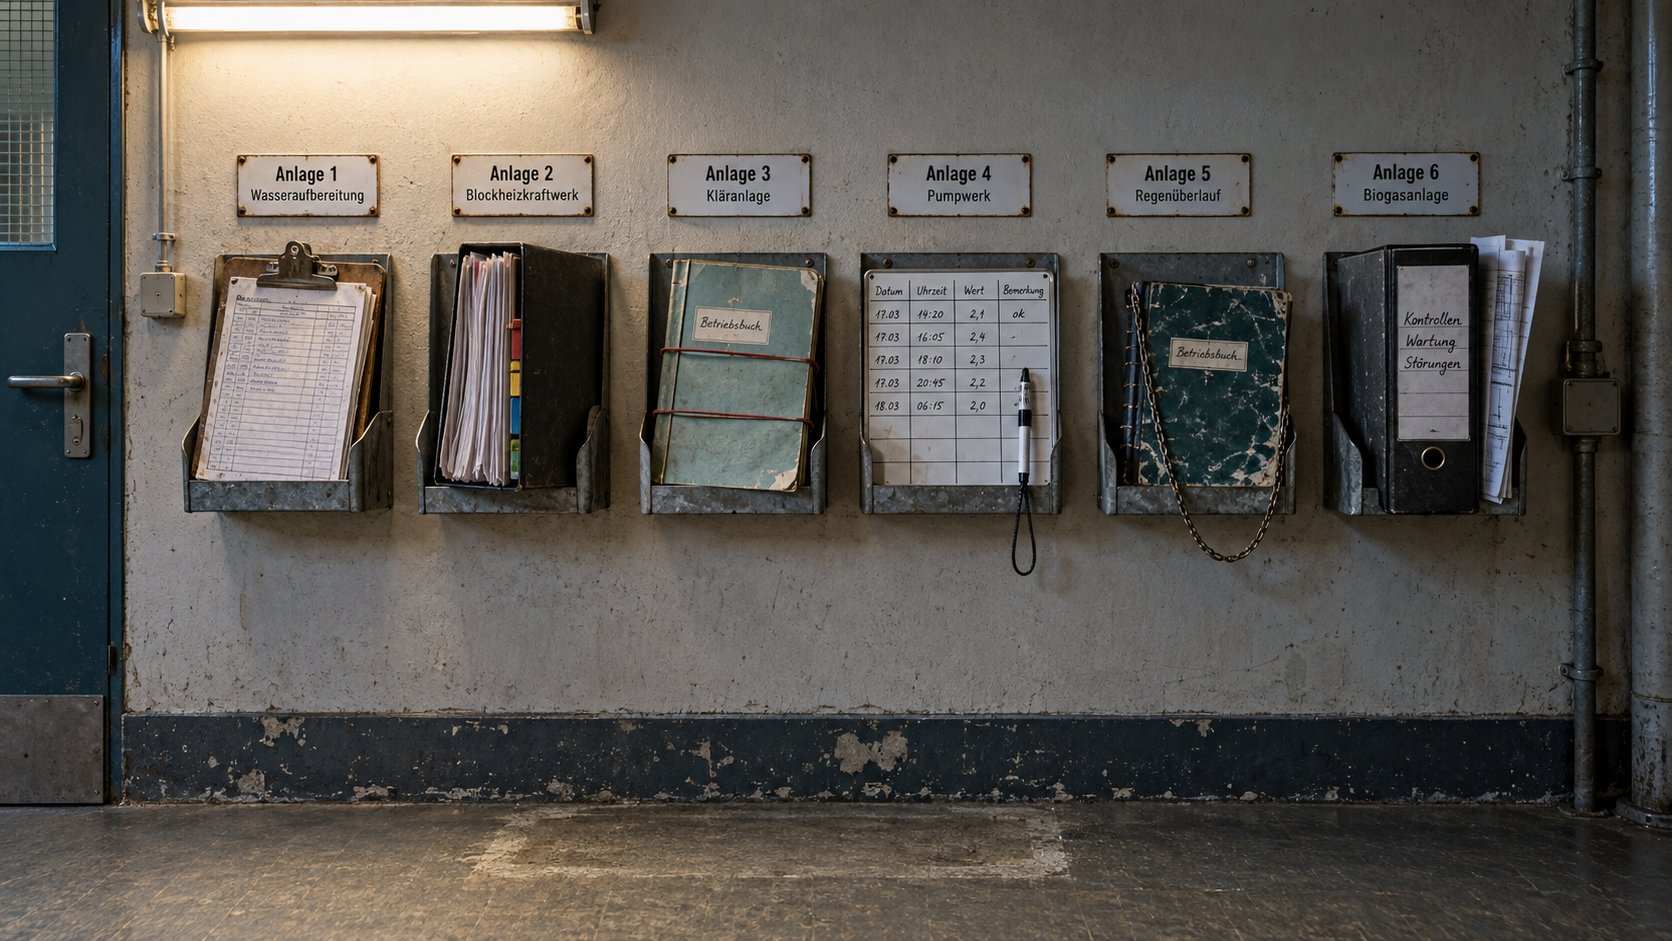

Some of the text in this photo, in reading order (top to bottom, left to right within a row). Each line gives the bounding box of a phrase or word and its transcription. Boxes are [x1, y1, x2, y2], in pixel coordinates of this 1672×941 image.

[276, 166, 336, 185] Anlage 1
[490, 165, 553, 185] Anlage 2
[706, 165, 770, 185] Anlage 3
[926, 165, 991, 185] Anlage 4
[1145, 165, 1210, 185] Anlage 5
[1373, 164, 1439, 184] Anlage 6
[251, 189, 364, 204] Wasseraufbereitung
[467, 188, 578, 201] Blockheizkraftwerk
[707, 190, 770, 205] Kläranlage
[928, 189, 990, 204] Pumpwerk
[1136, 189, 1221, 205] Regenüberlauf
[1364, 188, 1448, 204] Biogasanlage
[876, 285, 1043, 298] Datum Uhrzeit Wert Bemerkung
[876, 309, 1024, 320] 17.03 14:20 2,1 ok
[1404, 312, 1462, 325] Kontrollen
[875, 332, 985, 343] 17.03 16:05 2,4
[1407, 334, 1457, 353] Wartung
[875, 355, 985, 366] 17.03 18:10 2,3
[1405, 356, 1463, 375] Störungen
[874, 378, 985, 389] 17.03 20:45 2,2
[875, 401, 986, 412] 18.03 06:15 2,0
